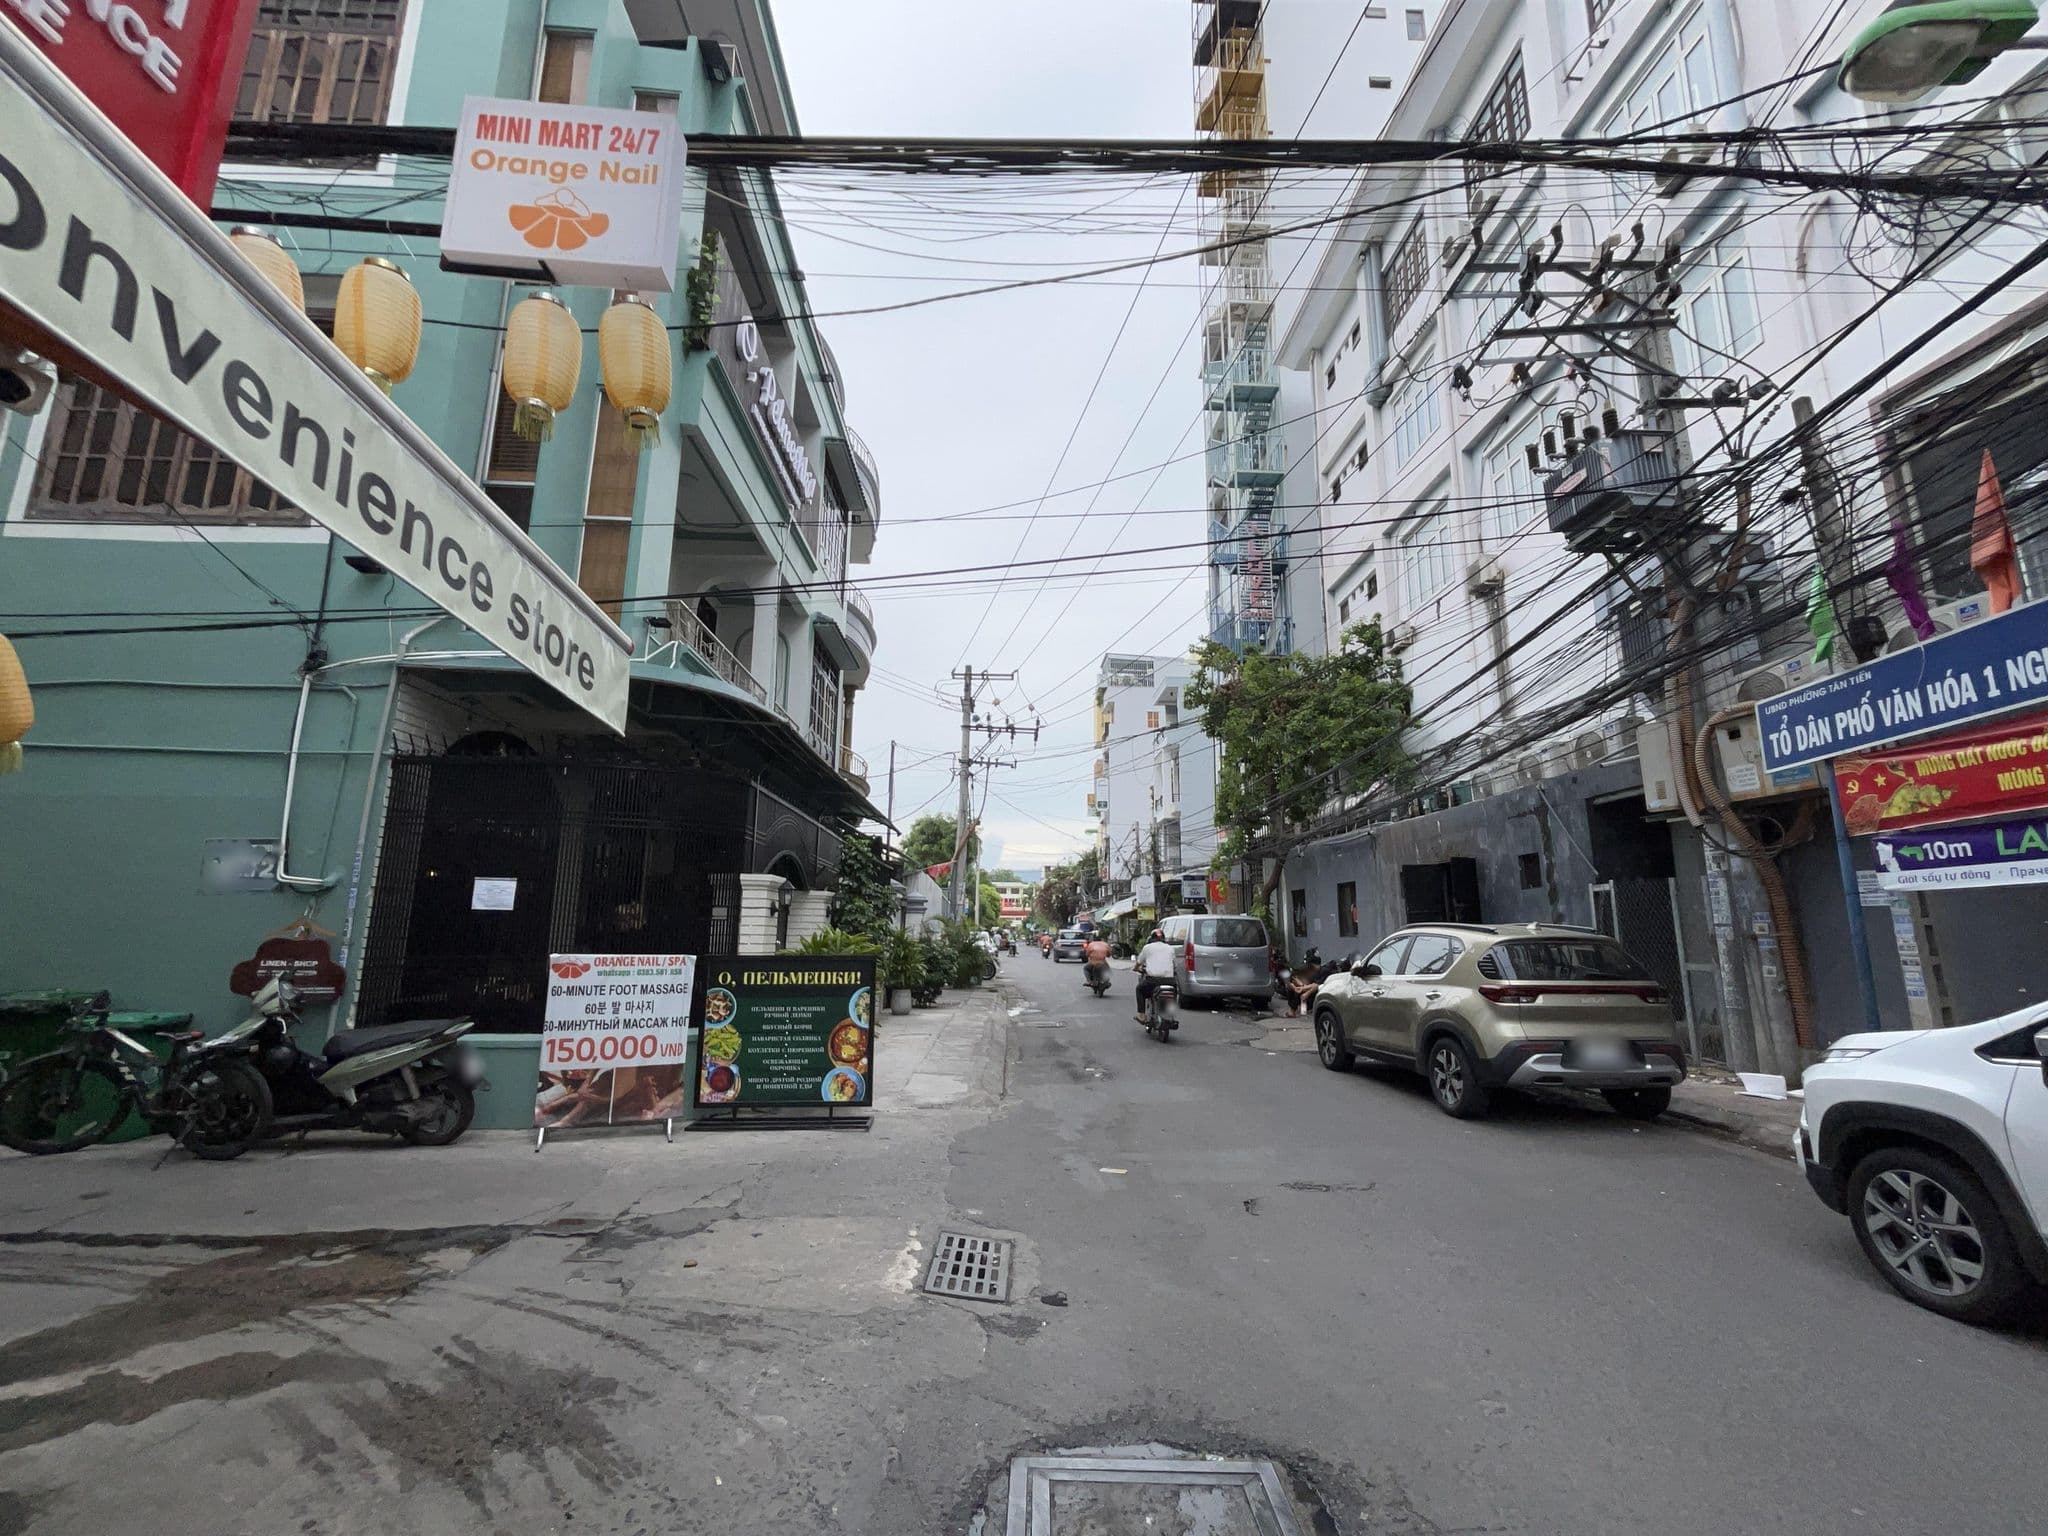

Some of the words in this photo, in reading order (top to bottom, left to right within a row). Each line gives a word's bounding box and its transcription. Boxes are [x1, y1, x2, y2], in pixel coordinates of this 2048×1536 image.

[476, 114, 531, 145] MINI
[538, 120, 603, 151] MART
[609, 126, 661, 155] 24/7
[470, 149, 588, 184] Orange
[599, 160, 659, 185] Nail
[507, 597, 597, 691] store
[1765, 701, 1787, 715] UBND
[1789, 687, 1827, 706] PHƯỜNG
[1828, 680, 1848, 693] TÂN
[1769, 715, 1792, 759] TỔ
[1795, 714, 1833, 752] DÂN
[1835, 690, 1874, 741] PHỐ
[1878, 686, 1924, 727] VĂN
[1926, 669, 1979, 714] HÓA
[1983, 665, 2001, 698] 1
[1914, 752, 1956, 776] MỪNG
[1997, 766, 2046, 791] MỪNG
[1922, 841, 1973, 861] 10m
[594, 956, 636, 967] ORANGE
[637, 956, 660, 967] NAIL
[667, 956, 687, 967] SPA
[551, 985, 606, 997] 60-MINUTE
[609, 984, 638, 996] FOOT
[640, 982, 688, 995] MASSAGE
[718, 971, 737, 987] О,
[743, 971, 862, 985] ПЕЛЬМЕШКИ!
[585, 1002, 607, 1015] 60분
[611, 1001, 621, 1014] 발
[625, 1000, 655, 1014] 마사지
[543, 1017, 620, 1032] 60-МИНУТНЫЙ
[622, 1017, 668, 1030] МАССАЖ
[545, 1034, 658, 1063] 150,000
[660, 1043, 683, 1057] VND
